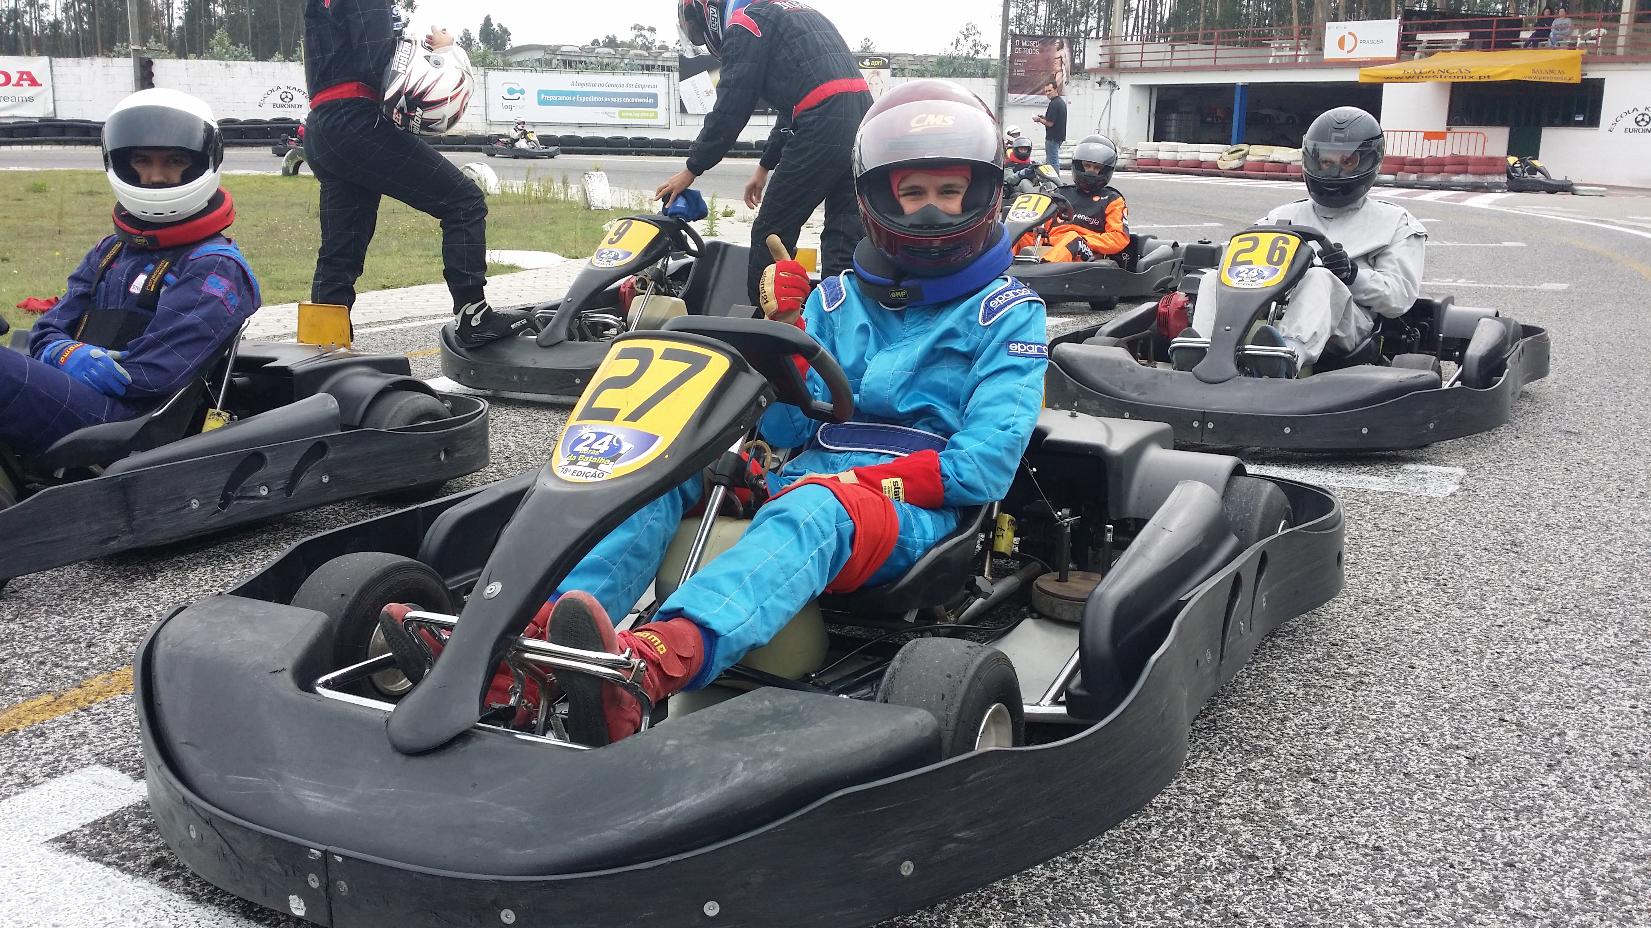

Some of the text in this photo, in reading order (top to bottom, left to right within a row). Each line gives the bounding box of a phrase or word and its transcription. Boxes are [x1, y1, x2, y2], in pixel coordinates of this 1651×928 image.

[910, 114, 956, 128] CMS
[1608, 106, 1639, 133] ESCOLA
[1015, 195, 1042, 211] 21
[608, 220, 634, 245] 9
[1230, 235, 1290, 268] 26
[1009, 342, 1048, 354] sparc
[576, 347, 712, 423] 27
[573, 432, 616, 453] 24
[571, 469, 605, 479] EDIÇÃO
